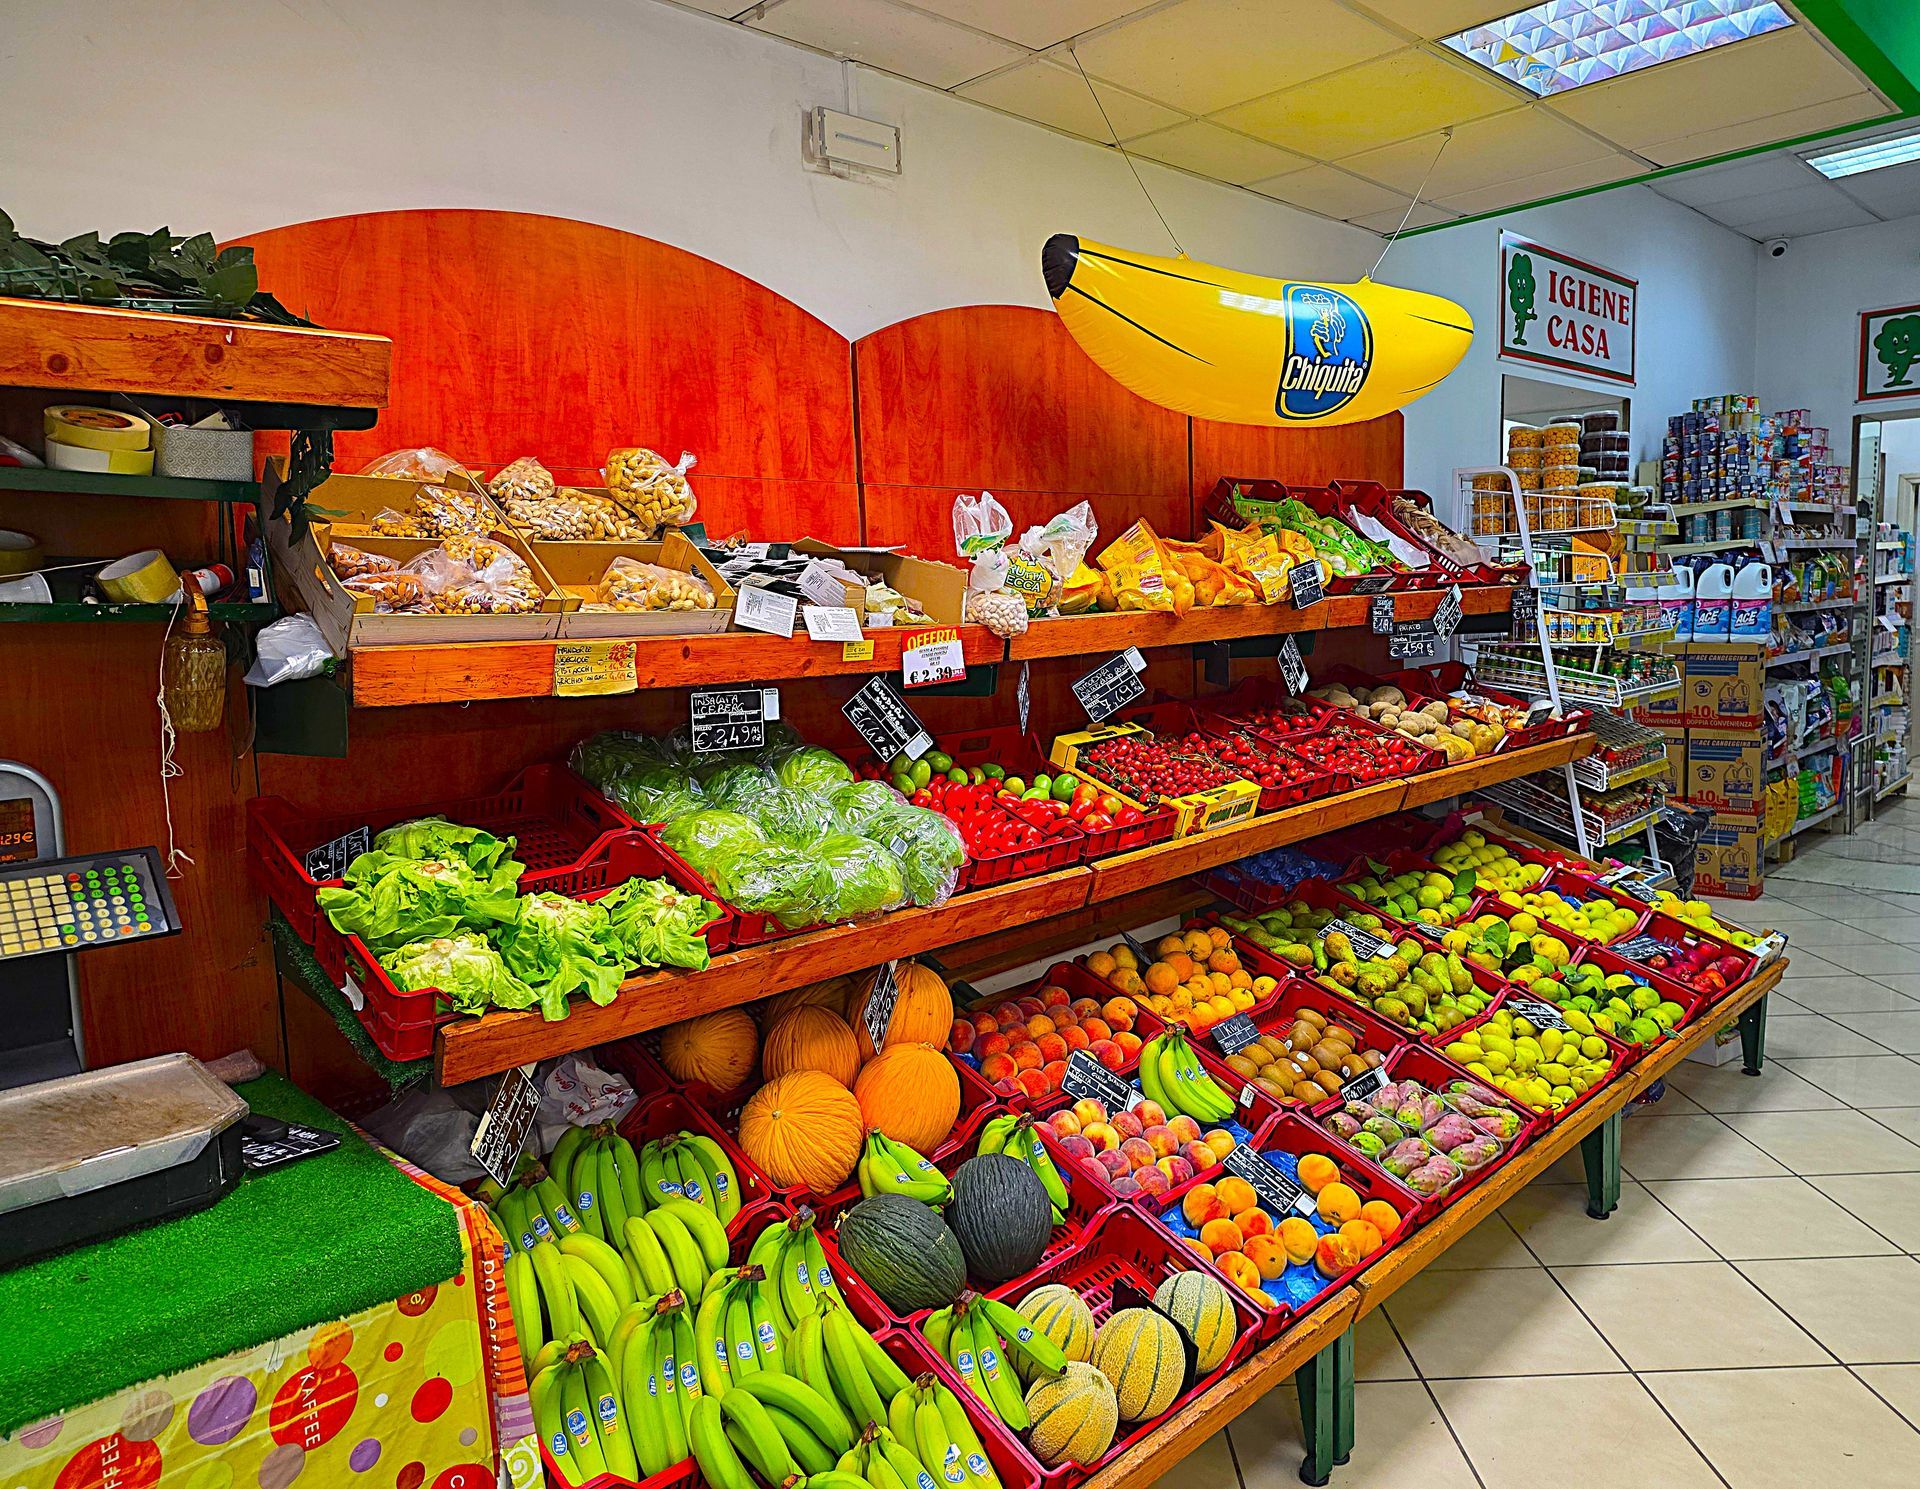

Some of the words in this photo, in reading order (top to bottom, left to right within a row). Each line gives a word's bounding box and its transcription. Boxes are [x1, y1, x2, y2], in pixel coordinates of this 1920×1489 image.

[1548, 270, 1629, 326] IGIENE
[1547, 315, 1610, 360] CASA
[1281, 356, 1363, 400] Chiquita
[1010, 565, 1045, 582] RUTTA
[1005, 575, 1040, 593] ECCA
[1698, 610, 1719, 623] ACE
[1736, 610, 1758, 623] ACE
[907, 629, 958, 651] OFFERTA
[1708, 654, 1748, 662] CANDEGGINA
[695, 694, 738, 707] INSALATA
[697, 703, 744, 715] ICEBERG
[1687, 719, 1709, 727] DOPPIA
[1709, 720, 1753, 729] CONVENIENZA
[694, 732, 712, 750] €
[716, 726, 750, 747] 2,49
[1712, 739, 1751, 747] CANDEGGINA
[480, 1090, 507, 1158] BANANE
[300, 1371, 321, 1448] KAFFEE
